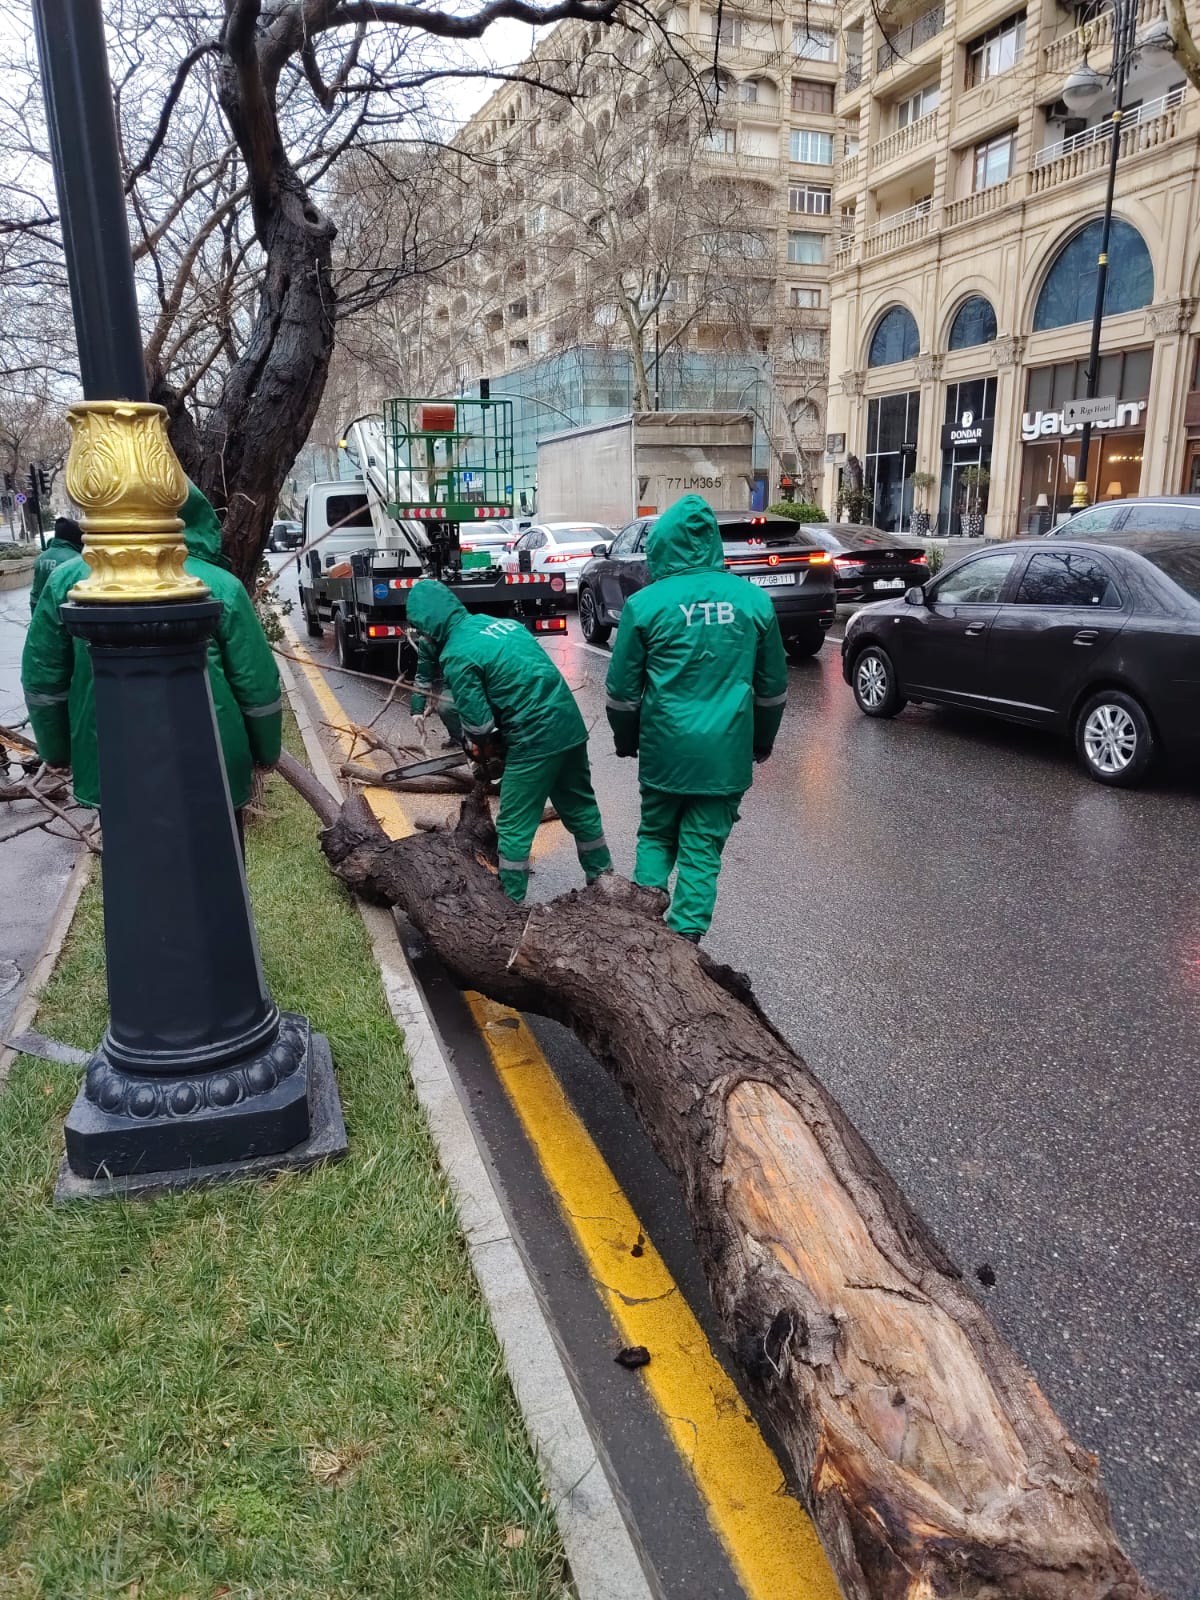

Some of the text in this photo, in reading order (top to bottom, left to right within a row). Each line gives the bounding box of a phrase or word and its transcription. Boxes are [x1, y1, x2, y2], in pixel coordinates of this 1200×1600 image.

[1080, 404, 1111, 416] Rigs Hotel
[951, 428, 982, 440] DONDAR
[667, 477, 722, 489] 77LM365
[679, 601, 735, 626] YTB
[480, 620, 518, 639] YTB
